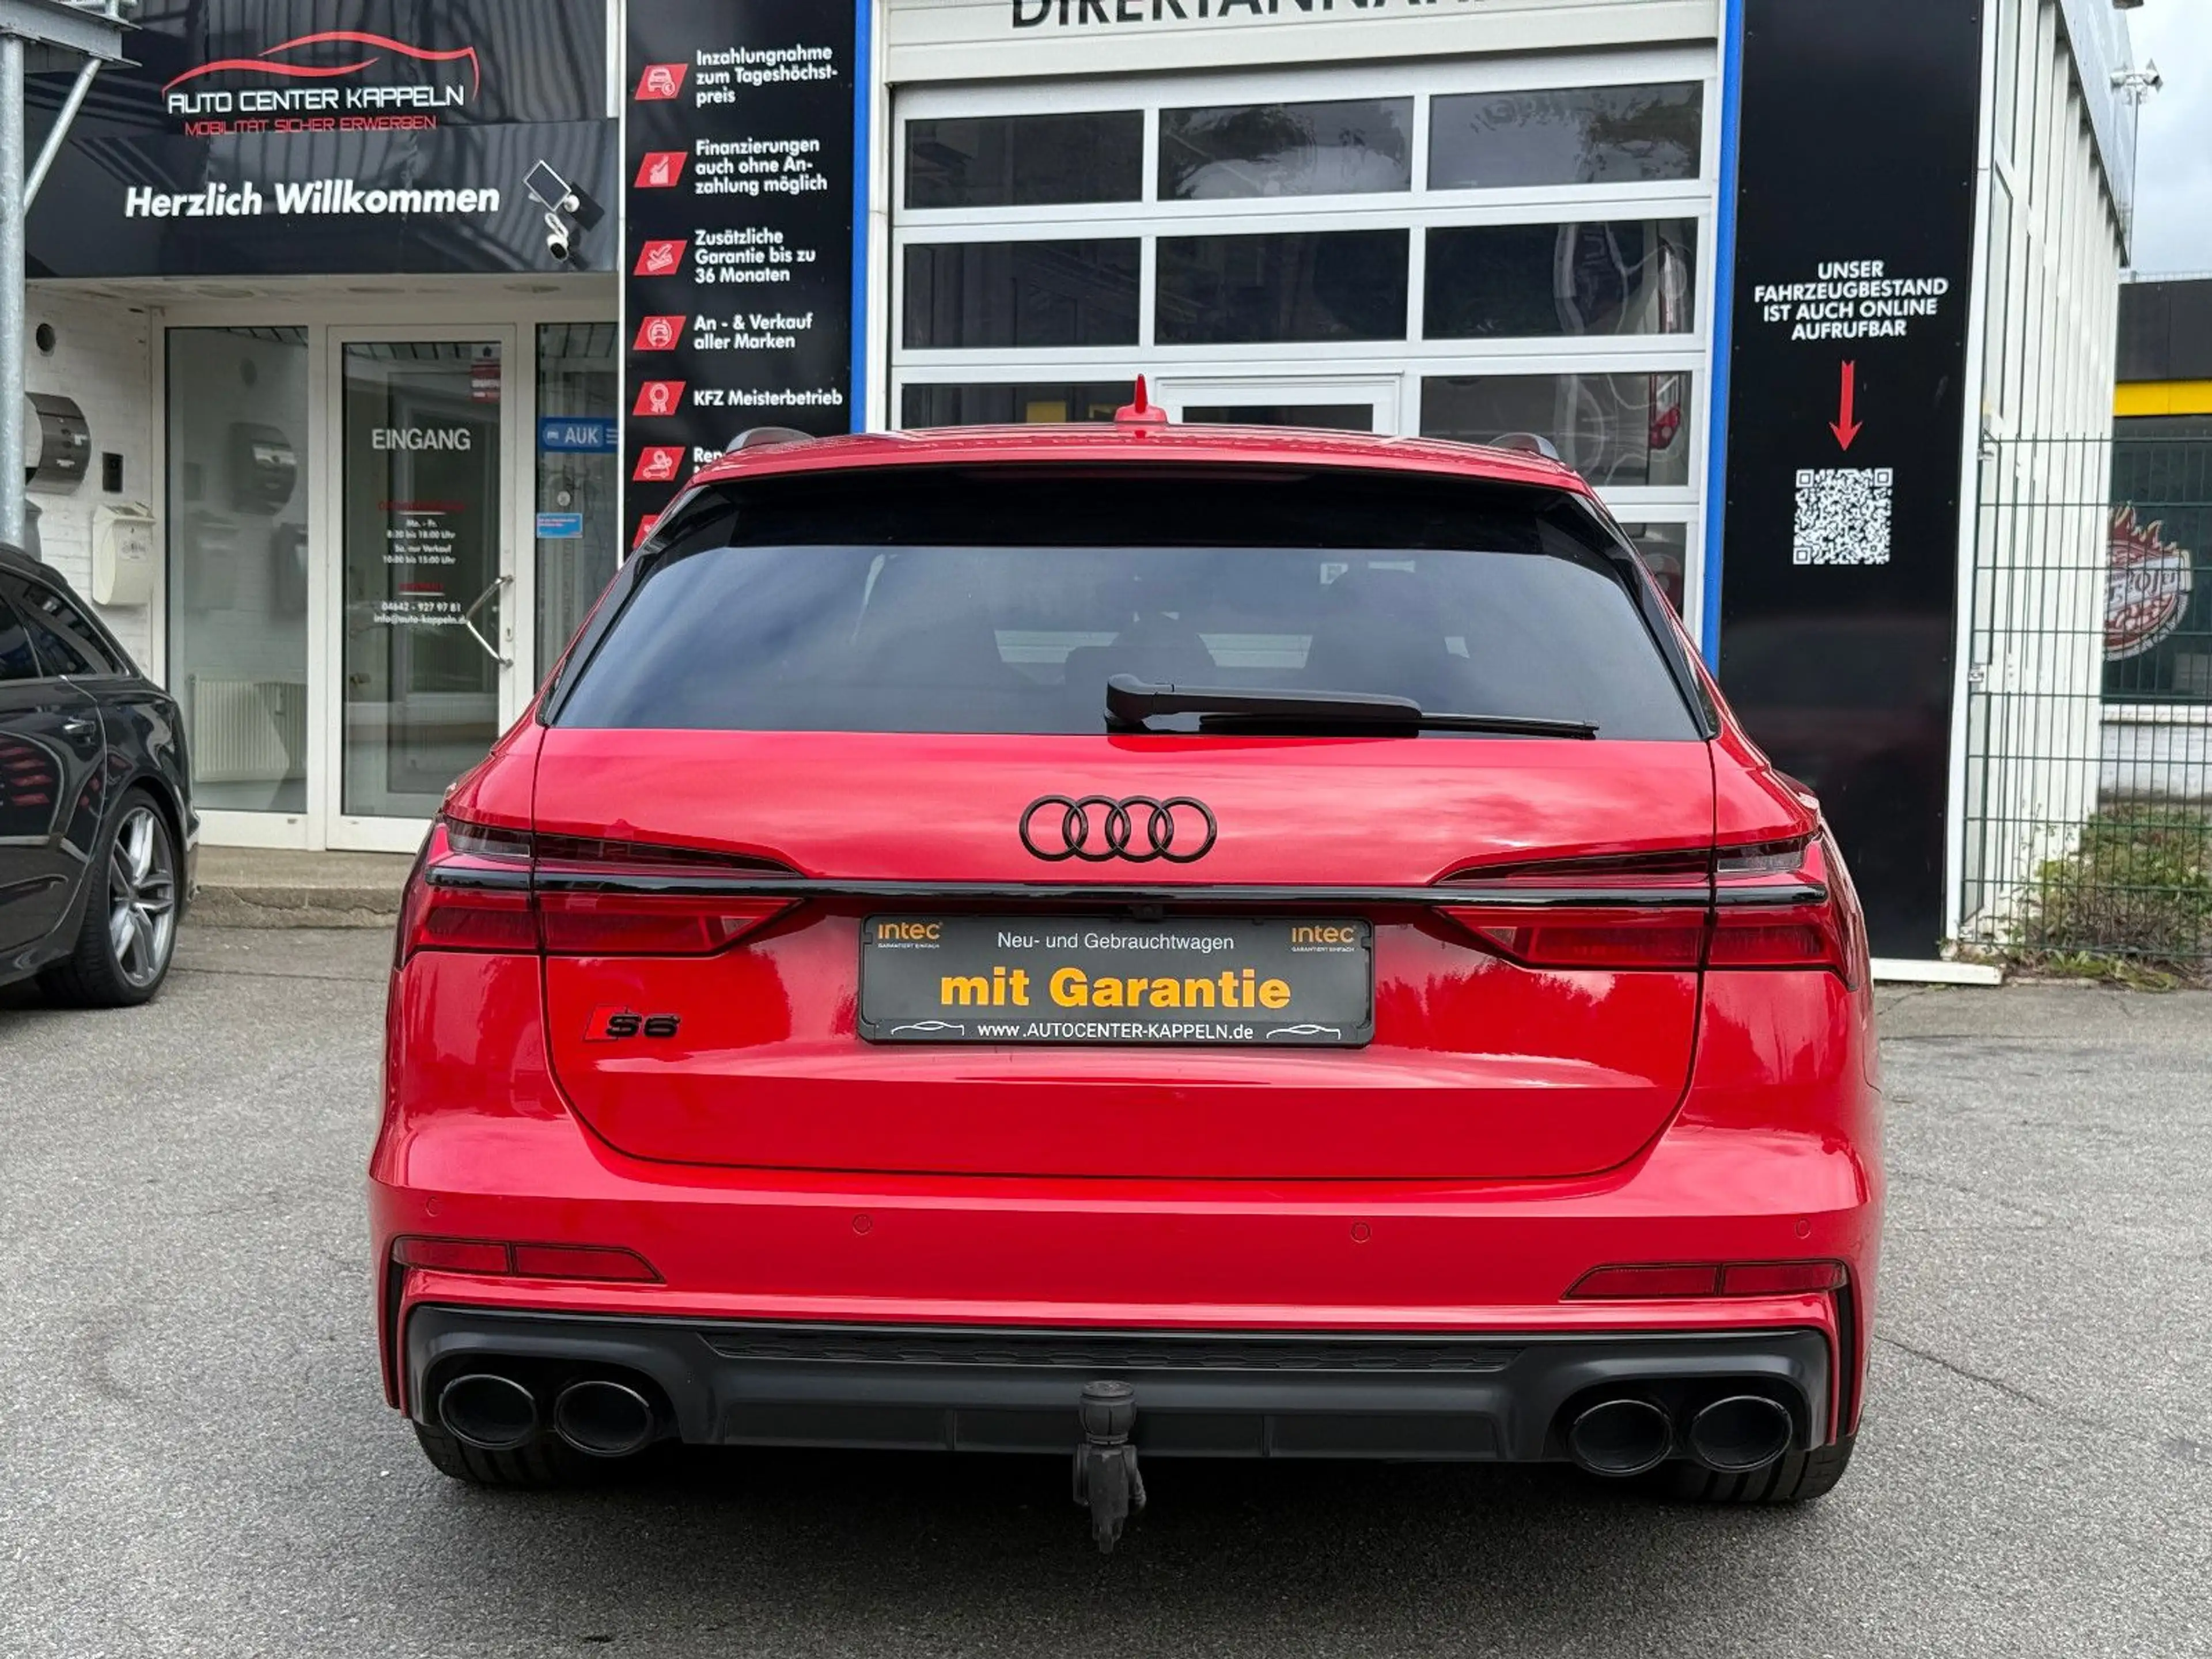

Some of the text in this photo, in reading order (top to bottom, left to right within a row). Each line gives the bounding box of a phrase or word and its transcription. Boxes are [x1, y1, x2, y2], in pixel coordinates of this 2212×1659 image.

[696, 44, 833, 66] Inzahlungnahme
[696, 63, 838, 86] zum Tageshöchst-
[168, 85, 464, 114] AUTO CENTER KAPPELN
[696, 86, 736, 108] preis
[185, 115, 436, 136] MOBILITÄT SICHER ERWERBEN
[696, 138, 820, 158] Finanzierungen
[695, 154, 813, 175] auch ohne An-
[695, 173, 828, 196] zahlung möglich
[125, 178, 500, 217] Herzlich Willkommen
[695, 227, 783, 247] Zusätzliche
[695, 245, 816, 265] Garantie bis zu
[695, 267, 790, 284] 36 Monaten
[1818, 260, 1884, 279] UNSER
[1754, 278, 1948, 302] FAHRZEUGBESTAND
[1763, 297, 1938, 322] IST AUCH ONLINE
[732, 314, 745, 330] &
[749, 312, 813, 330] Verkauf
[1791, 319, 1907, 340] AUFRUFBAR
[694, 332, 796, 350] aller Marken
[694, 388, 843, 406] KFZ Meisterbetrieb
[372, 427, 471, 450] EINGANG
[878, 923, 940, 940] intec
[1292, 926, 1354, 943] intec
[998, 931, 1234, 954] Neu- und Gebrauchtwagen
[941, 966, 1290, 1008] mit Garantie
[606, 1013, 681, 1037] S6
